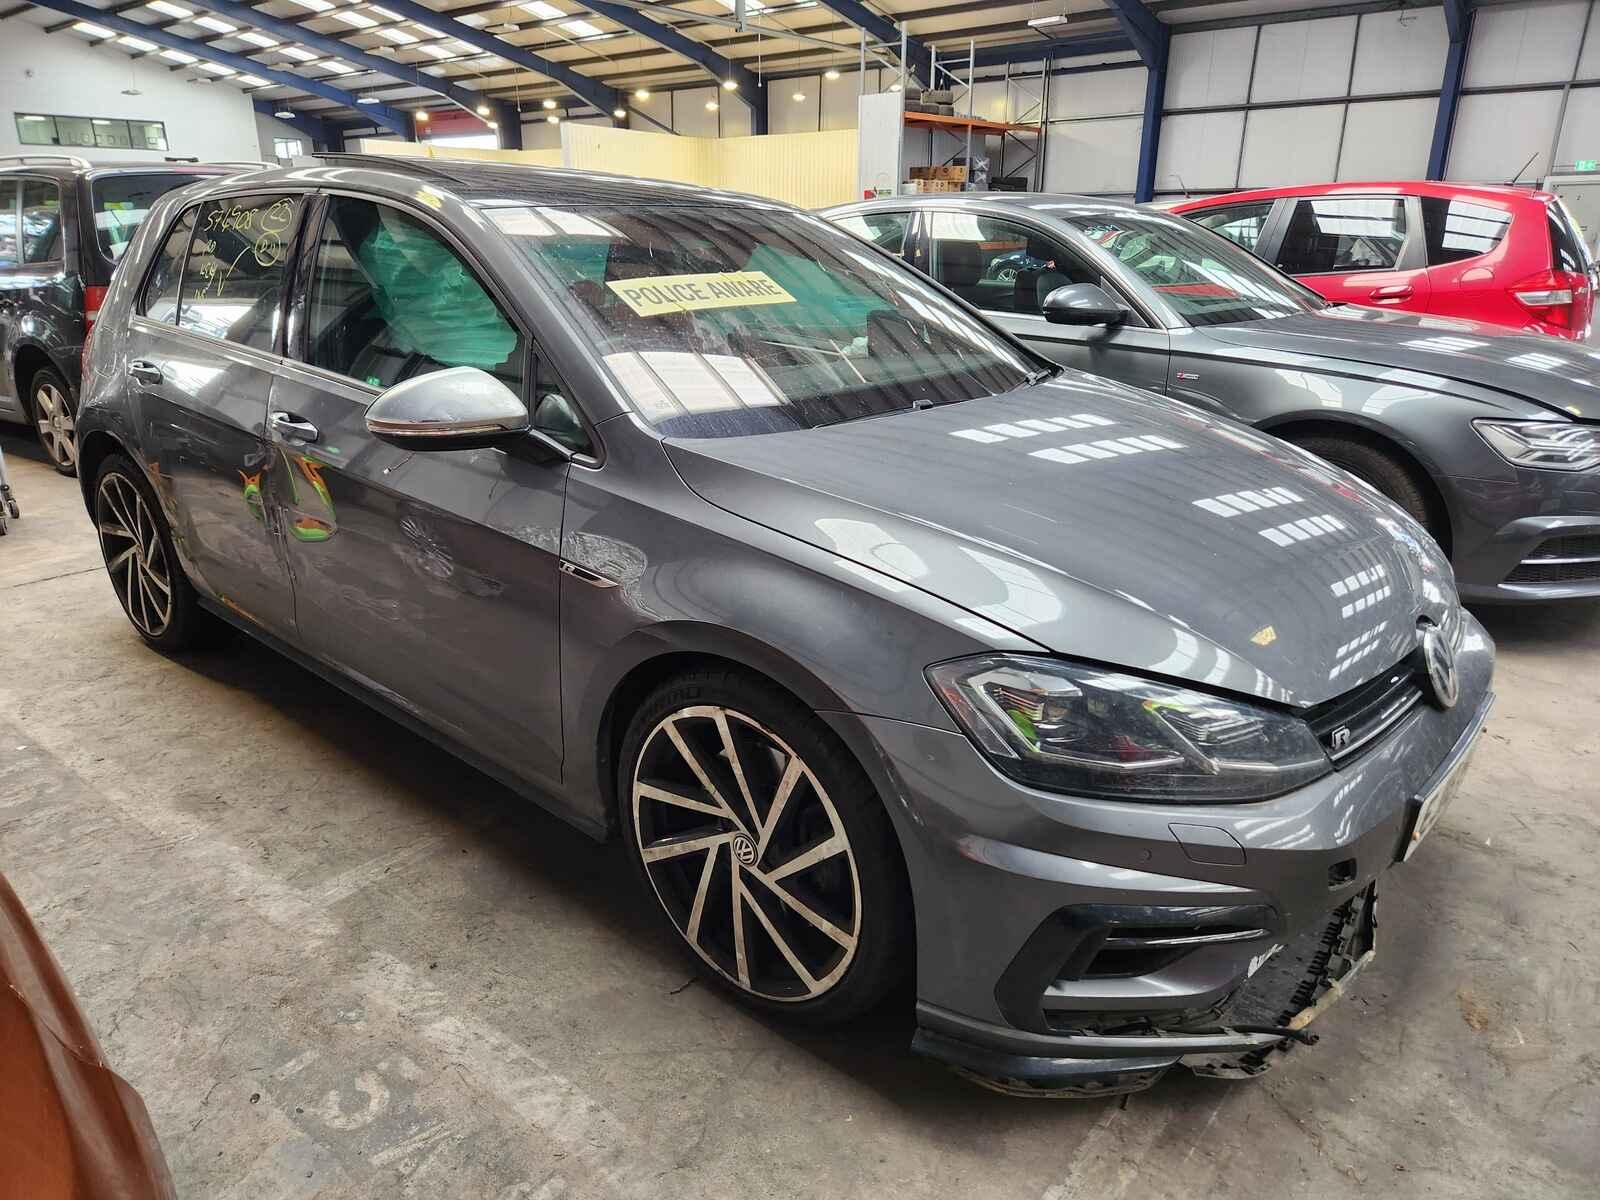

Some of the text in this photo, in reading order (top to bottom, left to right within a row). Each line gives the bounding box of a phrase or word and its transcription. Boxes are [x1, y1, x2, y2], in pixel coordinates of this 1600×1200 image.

[623, 280, 783, 307] POLICE AWARE
[1331, 725, 1350, 750] R
